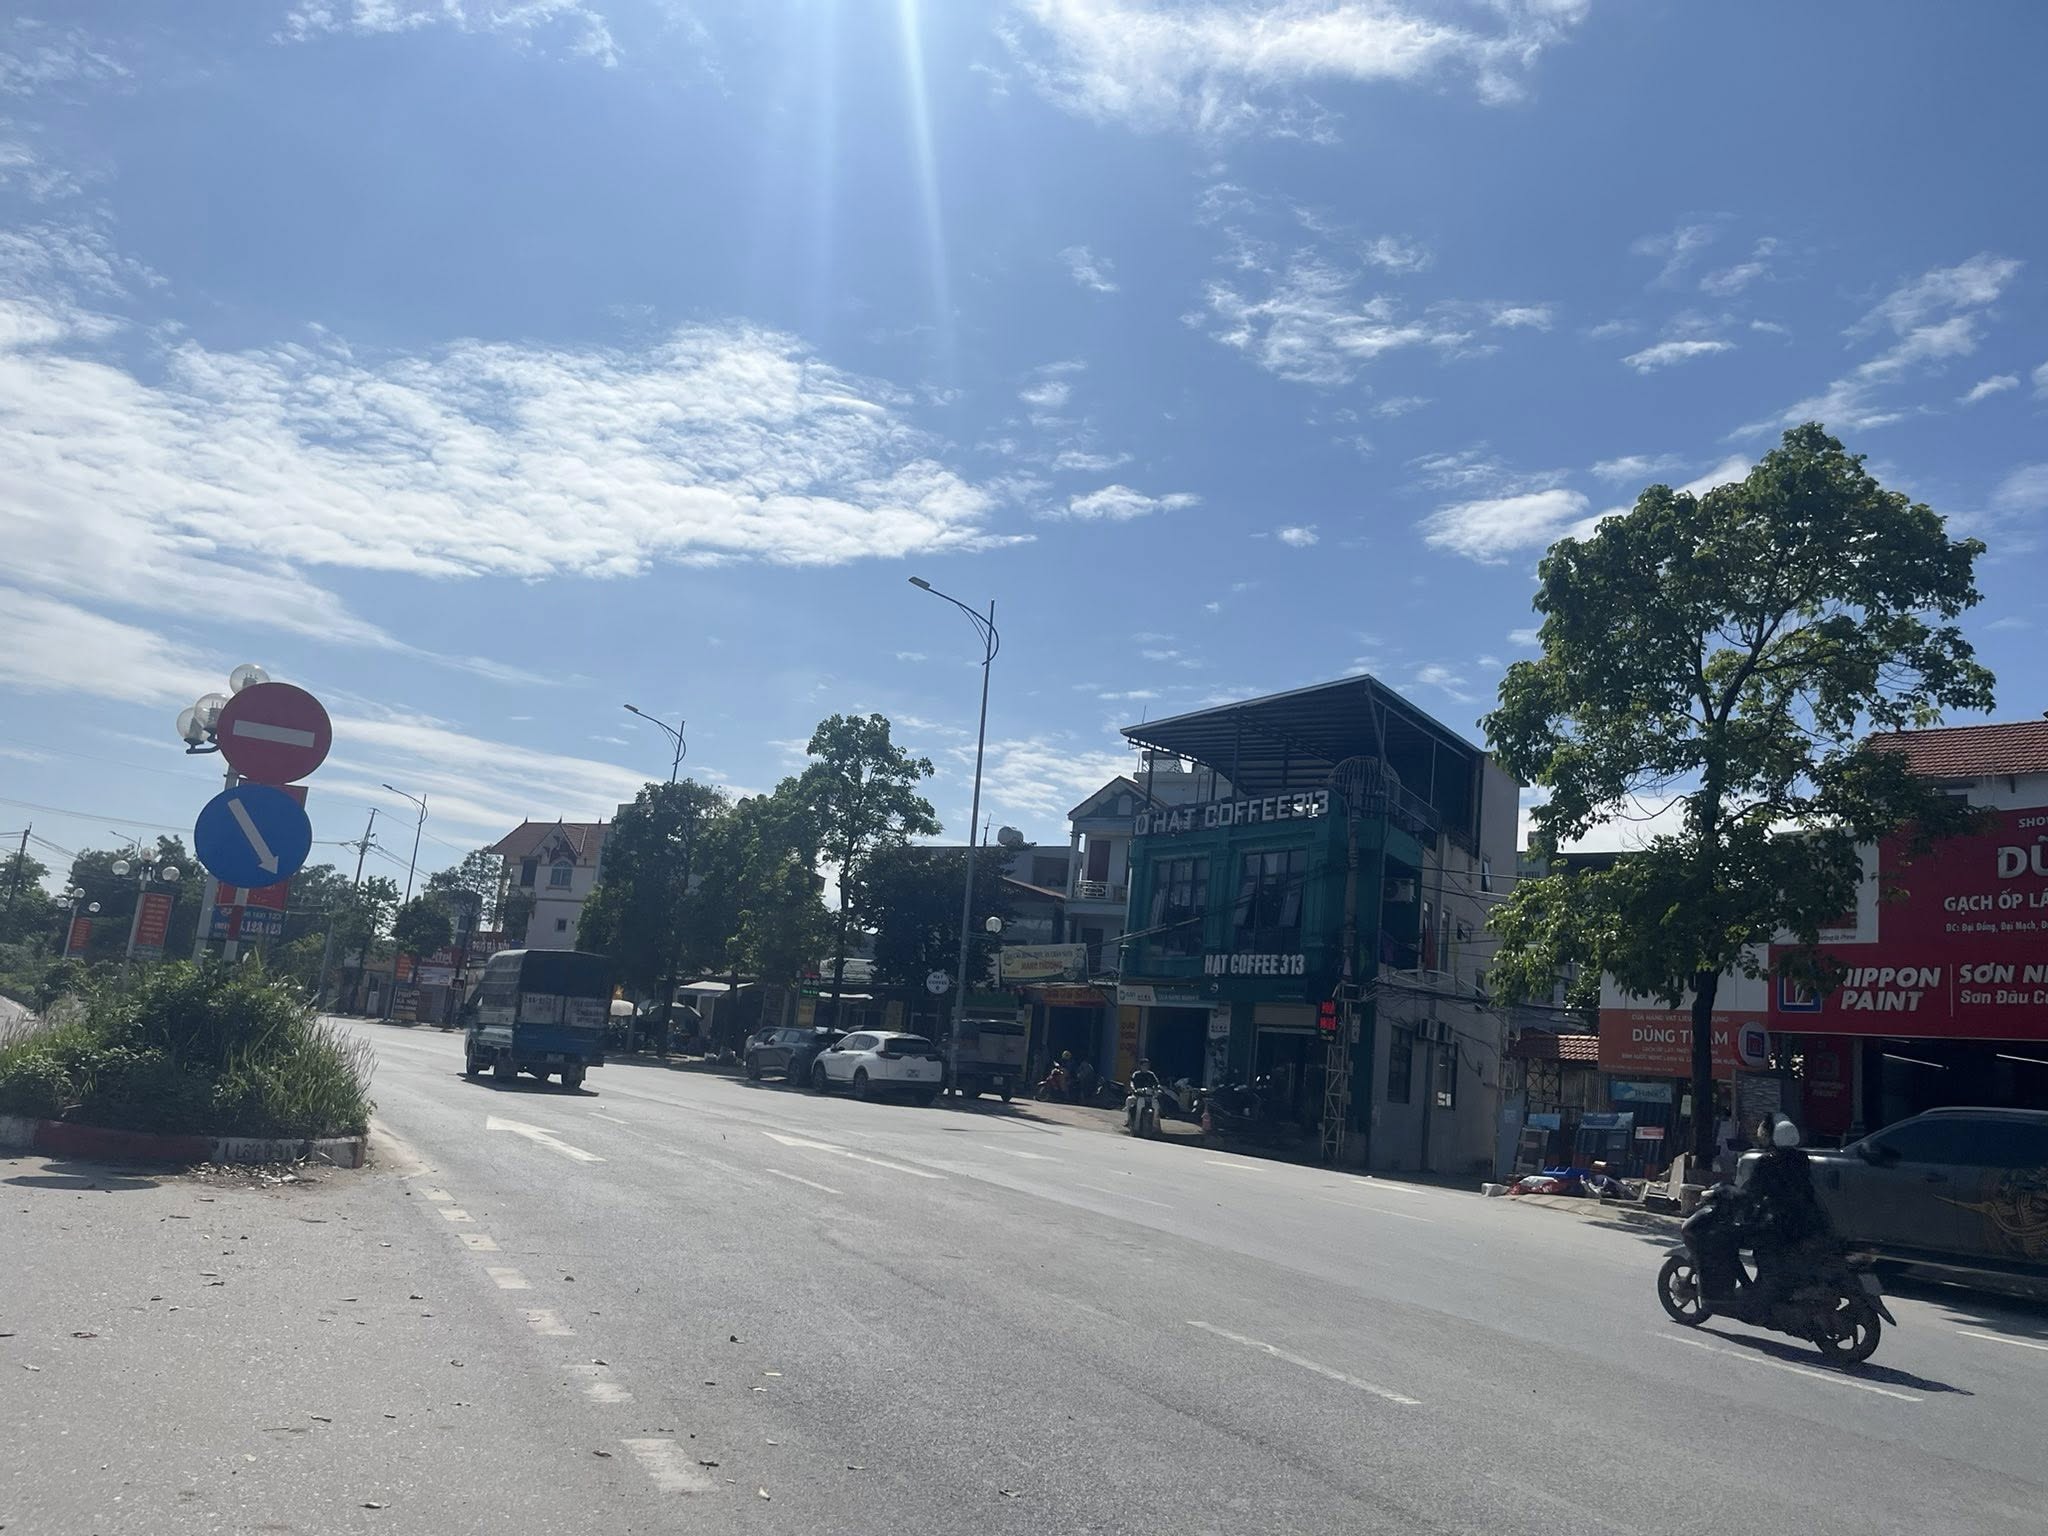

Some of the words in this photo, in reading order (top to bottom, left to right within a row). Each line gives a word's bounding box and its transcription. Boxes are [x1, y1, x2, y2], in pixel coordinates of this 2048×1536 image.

[1204, 795, 1290, 829] COFFEE
[1944, 895, 1993, 916] GẠCH
[1998, 887, 2024, 910] ỐP
[1204, 954, 1228, 977] HẠT
[1230, 953, 1279, 975] COFFEE
[1280, 954, 1305, 975] 313
[1959, 962, 2015, 984] SƠN
[1841, 990, 1925, 1012] PAINT
[1960, 989, 1992, 1005] Sơn
[1632, 1024, 1676, 1044] DŨNG
